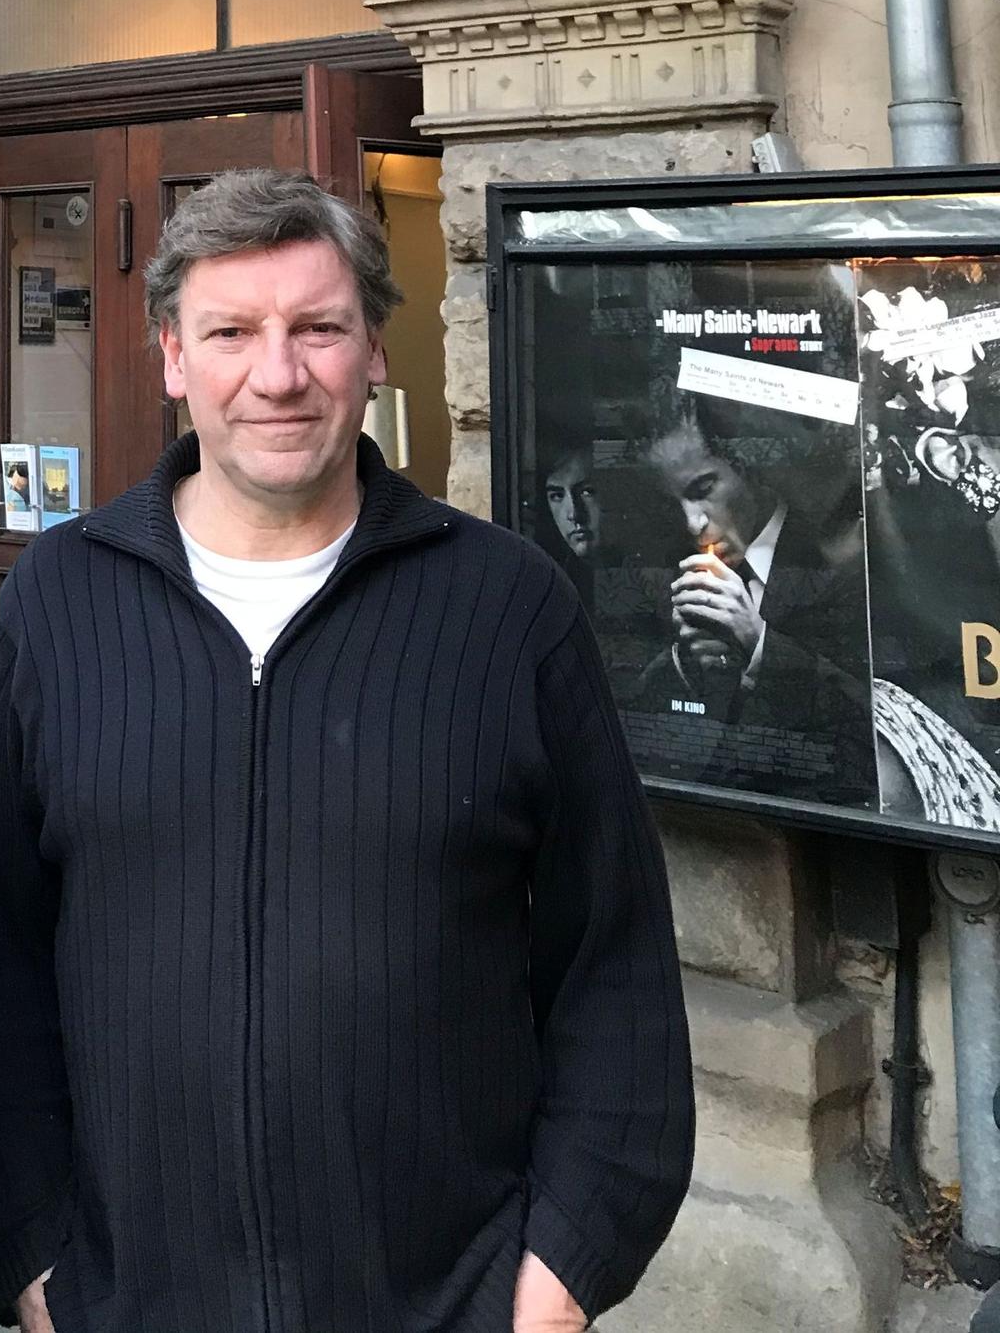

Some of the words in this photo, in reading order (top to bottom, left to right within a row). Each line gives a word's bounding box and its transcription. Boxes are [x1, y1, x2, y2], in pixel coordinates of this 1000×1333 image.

[663, 309, 702, 337] Many
[704, 309, 752, 334] Saints
[757, 309, 822, 334] Newark
[704, 366, 723, 378] Many
[684, 700, 706, 715] KINO
